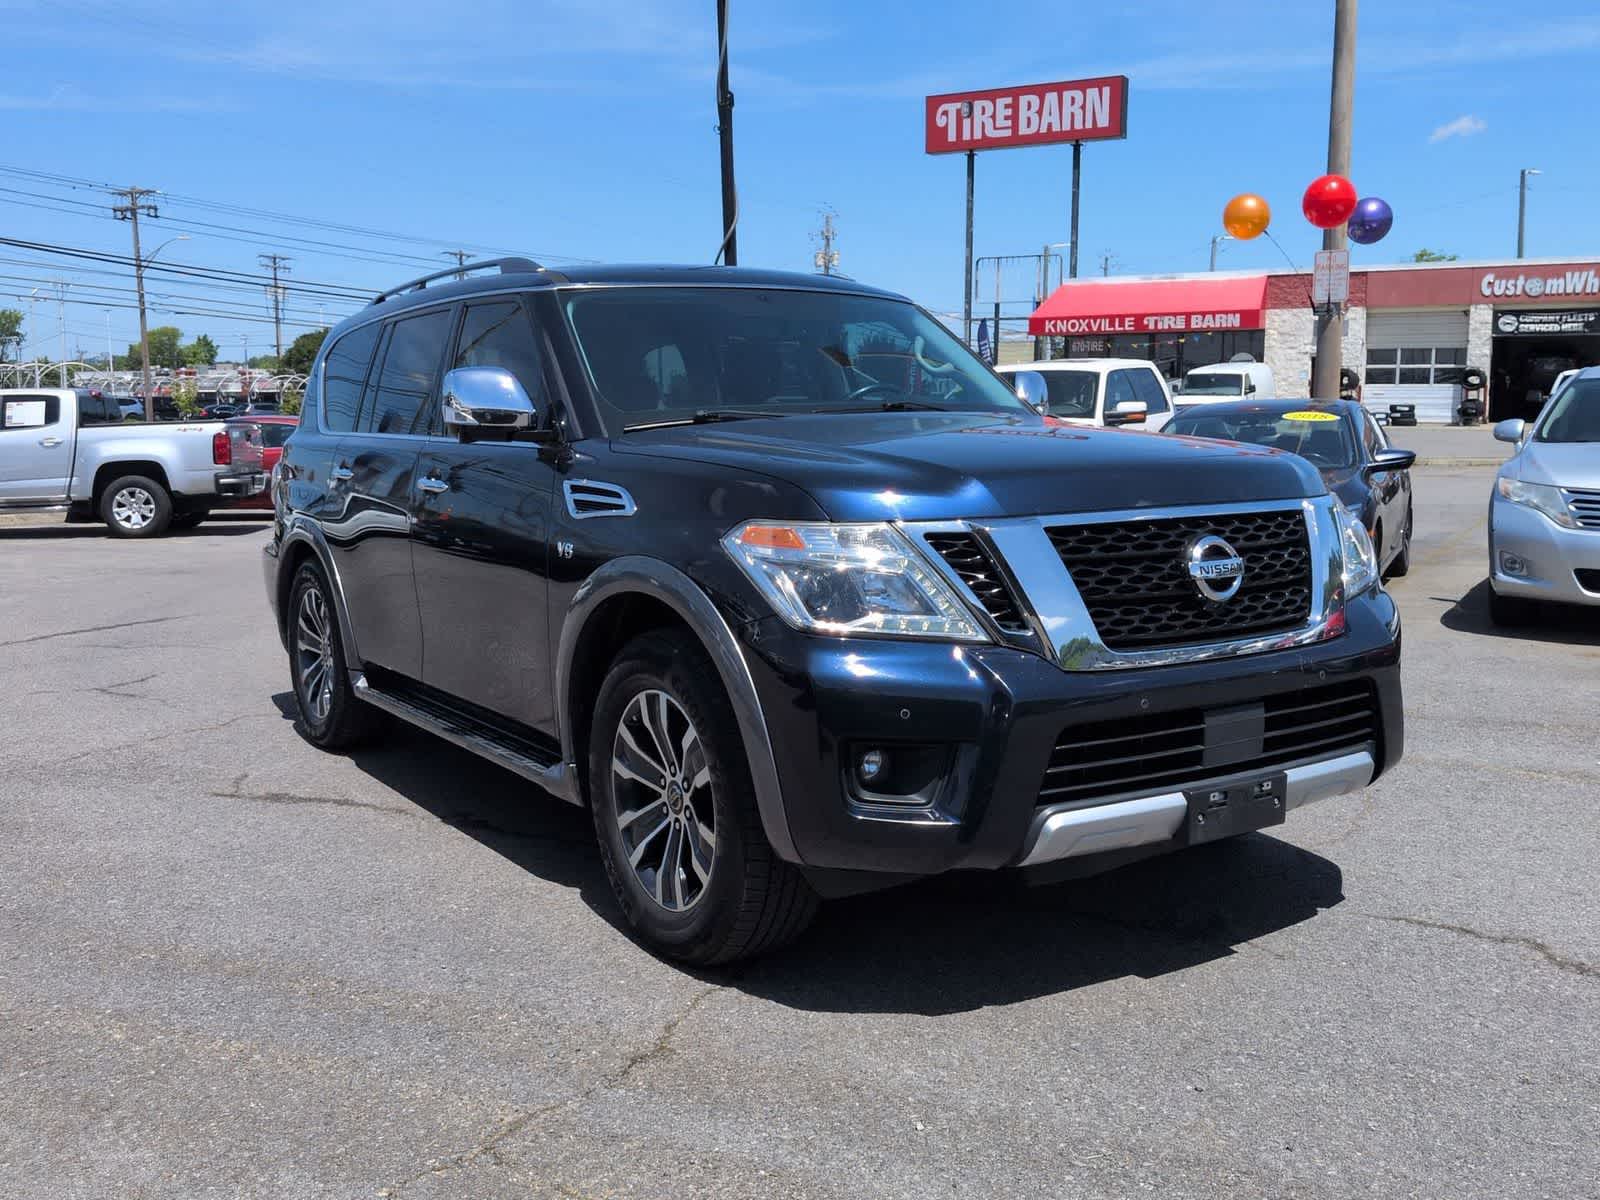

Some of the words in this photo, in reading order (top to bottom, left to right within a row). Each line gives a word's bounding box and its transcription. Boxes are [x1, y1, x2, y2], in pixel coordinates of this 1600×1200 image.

[1018, 86, 1111, 135] BARN
[1045, 317, 1135, 333] KNOXVILLE
[1190, 313, 1240, 328] BARN
[557, 541, 574, 559] V8
[1200, 562, 1243, 575] NISSAN
